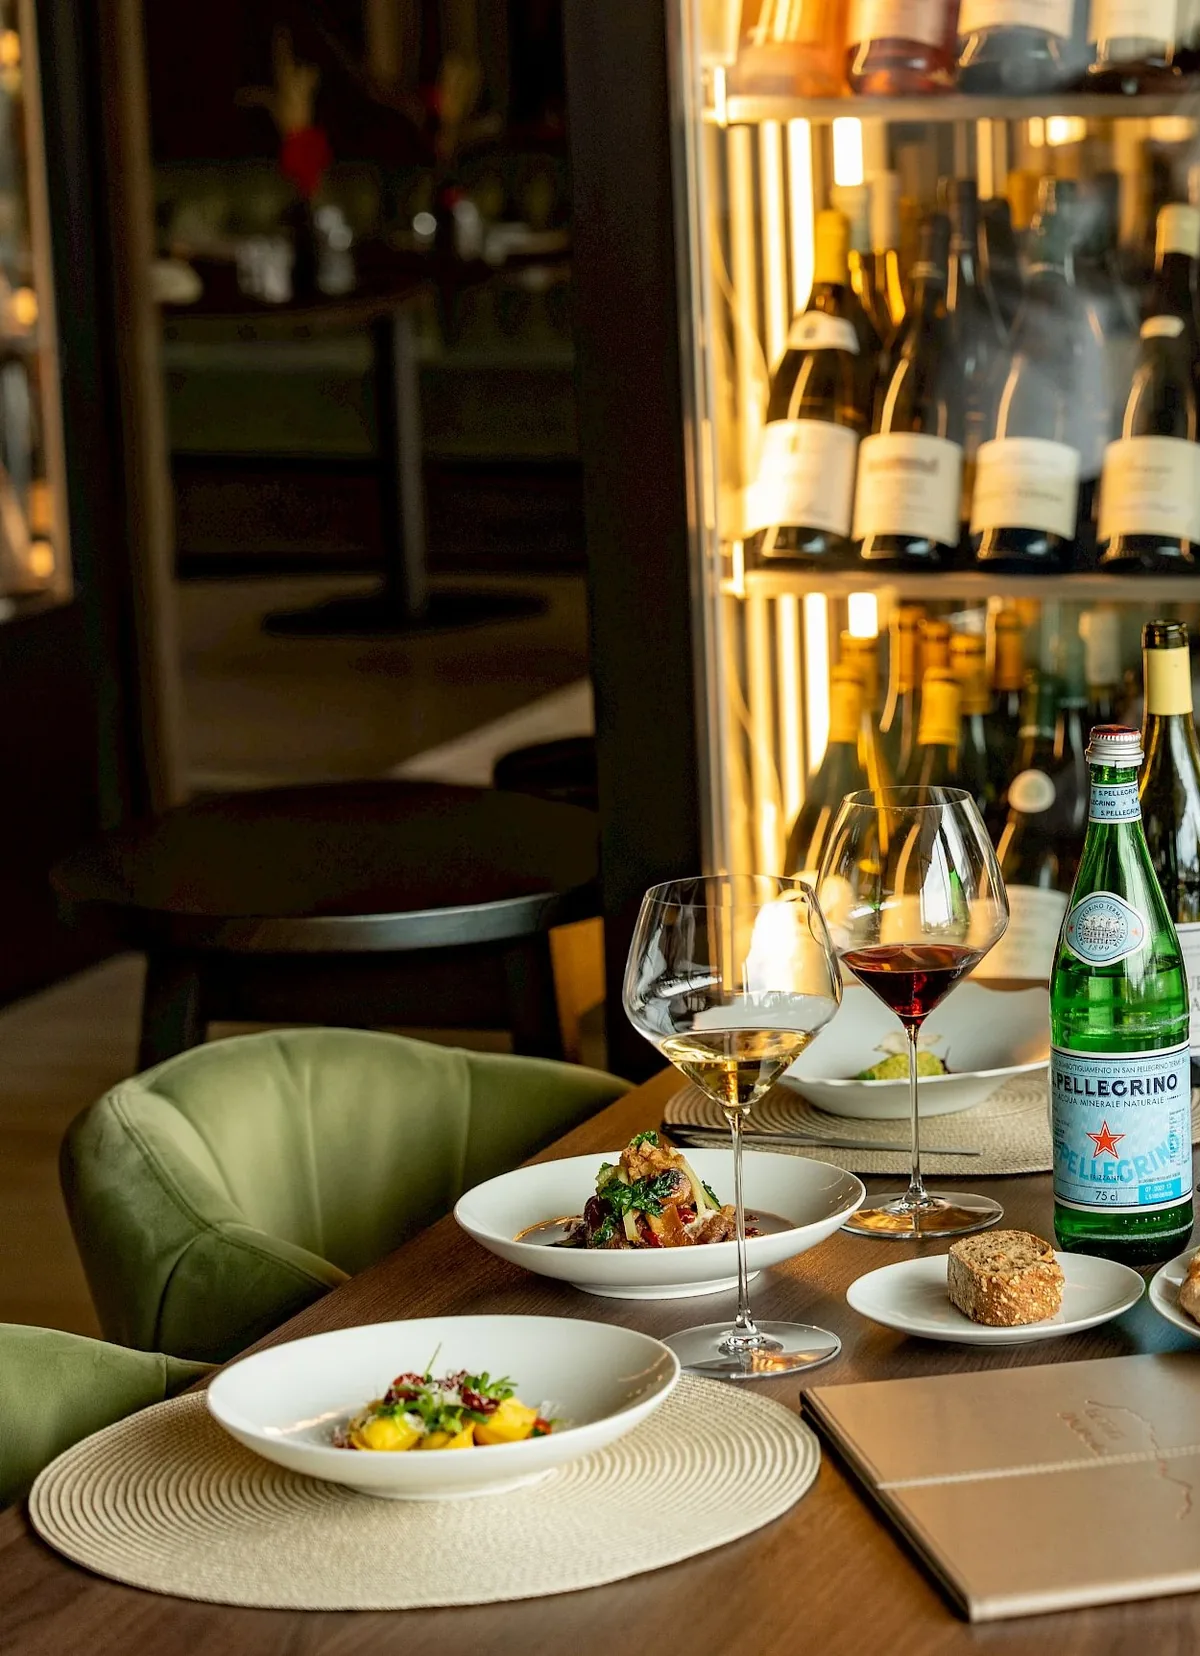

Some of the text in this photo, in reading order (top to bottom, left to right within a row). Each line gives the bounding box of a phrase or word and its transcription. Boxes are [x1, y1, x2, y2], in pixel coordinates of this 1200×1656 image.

[1122, 1066, 1136, 1074] SAN
[1136, 1062, 1169, 1073] PELLEGRINO
[1079, 1098, 1121, 1108] MINERALE
[1123, 1096, 1165, 1108] NATURALE
[1089, 1174, 1124, 1182] FRIZZANTE
[1095, 1190, 1119, 1201] 75 cl
